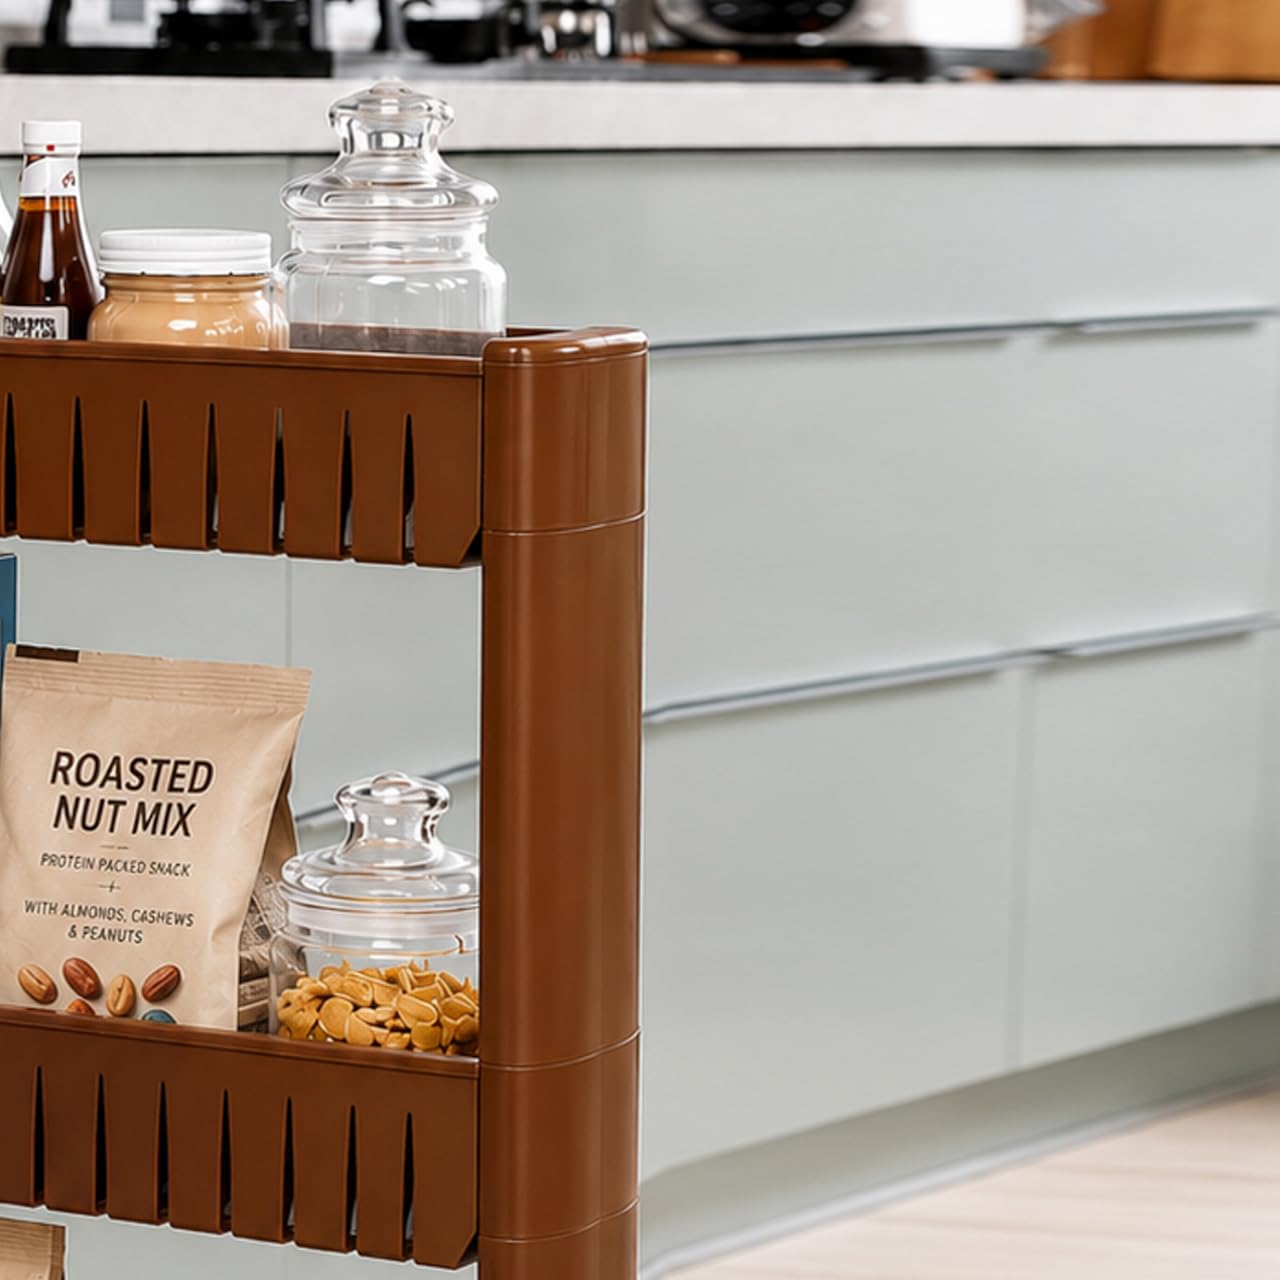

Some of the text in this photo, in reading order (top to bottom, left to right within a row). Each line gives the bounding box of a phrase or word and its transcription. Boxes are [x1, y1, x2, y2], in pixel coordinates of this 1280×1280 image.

[50, 751, 214, 794] ROASTED
[53, 794, 197, 837] NUT MIX
[40, 852, 192, 877] PROTEIN PACKED SNACK
[24, 900, 58, 915] WITH
[131, 909, 194, 927] CASHEWS
[67, 924, 144, 944] & PEANUTS
